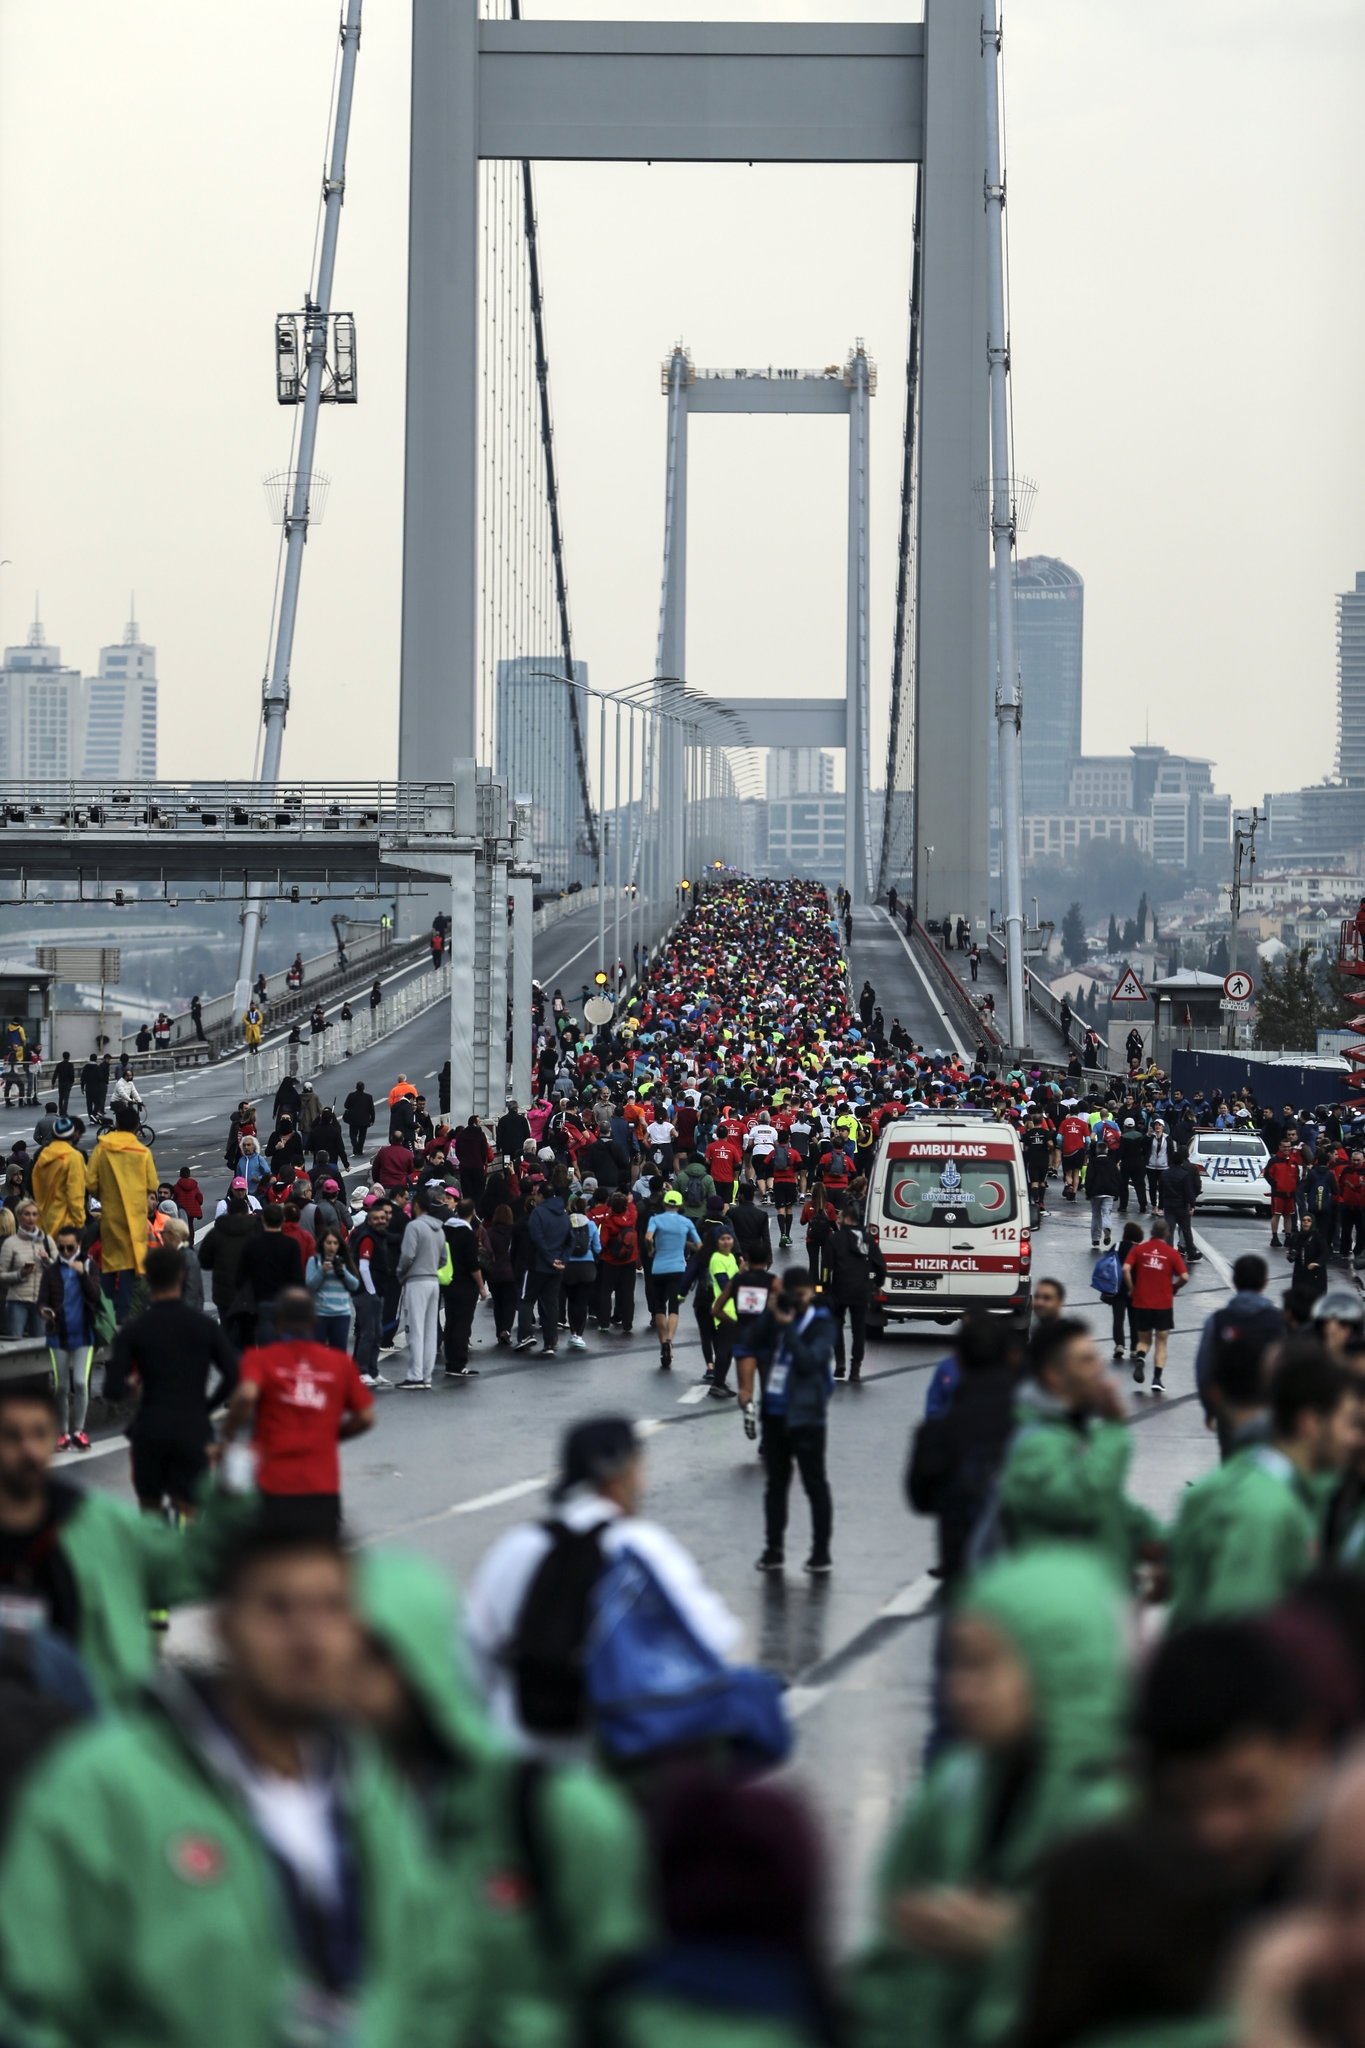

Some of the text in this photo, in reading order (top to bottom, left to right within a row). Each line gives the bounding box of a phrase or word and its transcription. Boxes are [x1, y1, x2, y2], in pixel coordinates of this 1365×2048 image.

[909, 1144, 987, 1157] AMBULANS
[884, 1225, 908, 1239] 112
[991, 1228, 1016, 1240] 112
[914, 1257, 979, 1271] HIZIR ACİL
[893, 1279, 903, 1287] 34
[907, 1279, 923, 1288] FTS
[925, 1279, 936, 1288] 96
